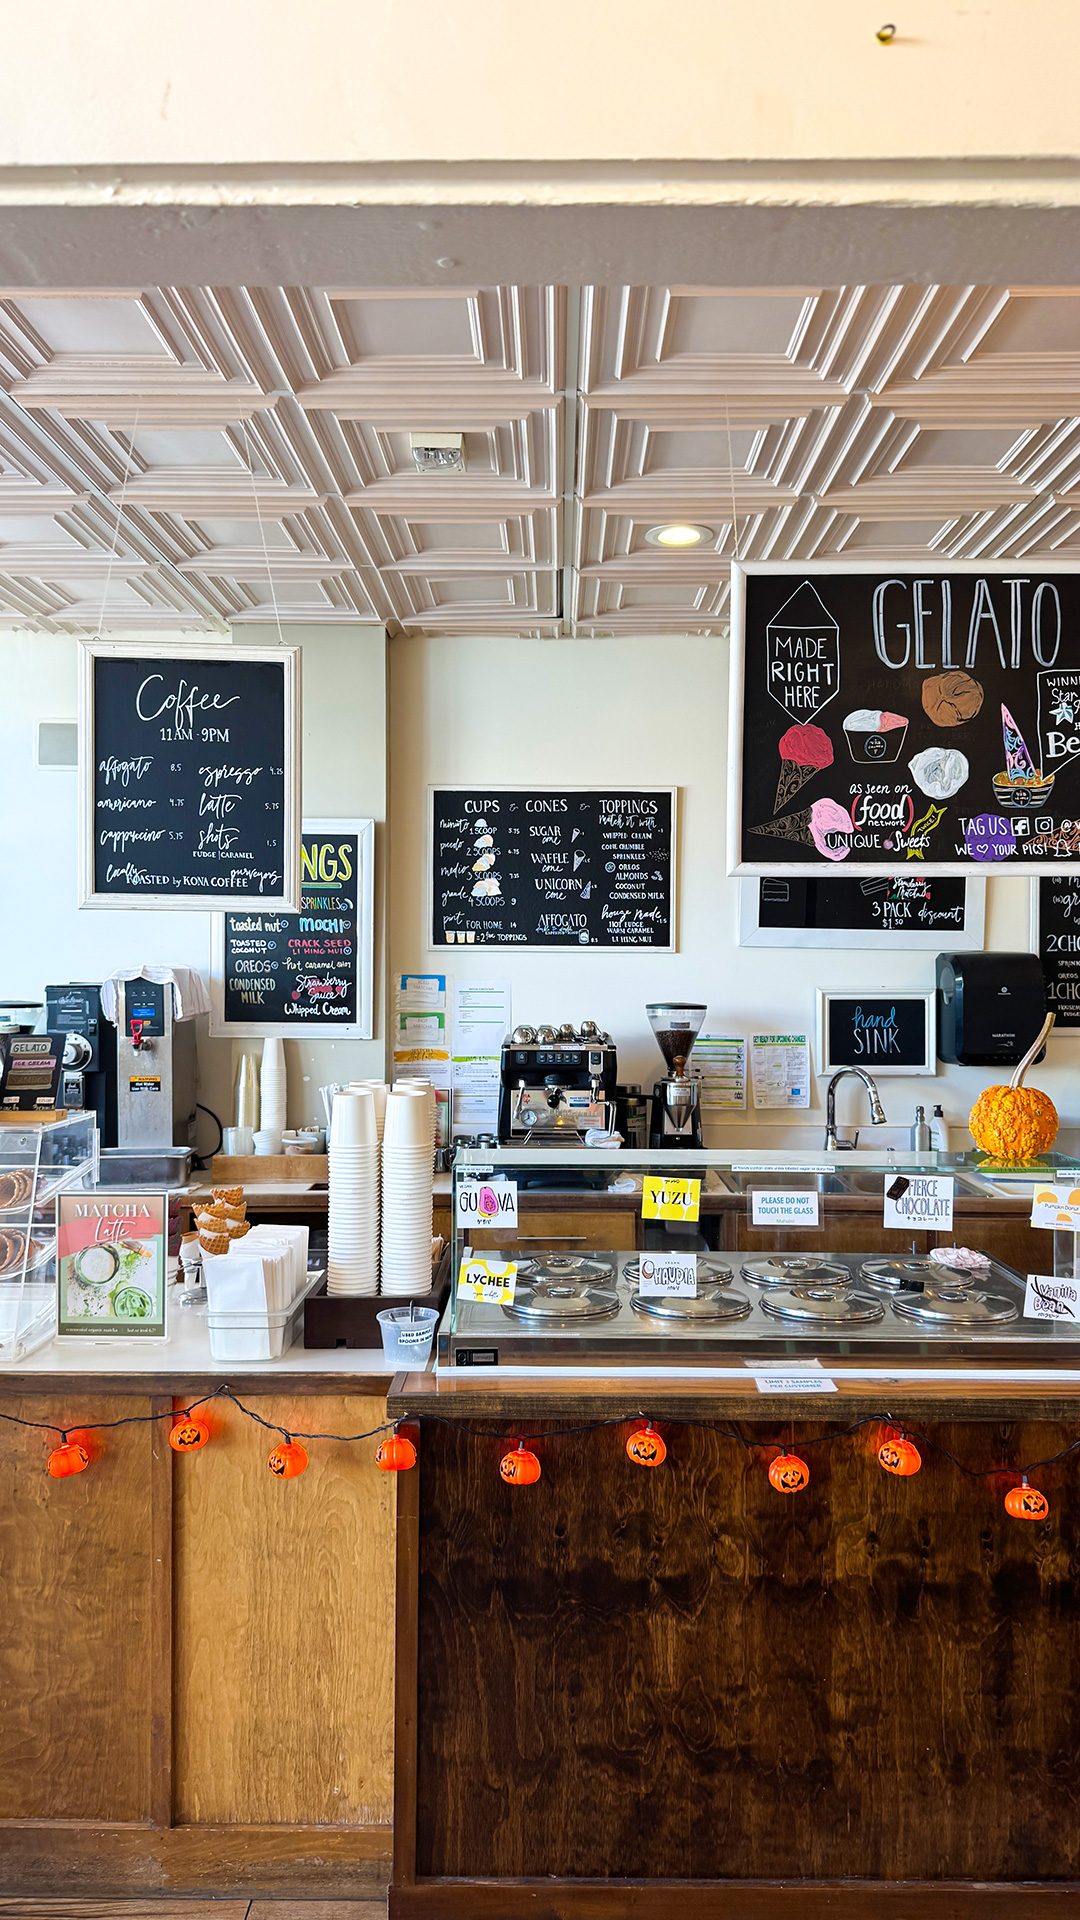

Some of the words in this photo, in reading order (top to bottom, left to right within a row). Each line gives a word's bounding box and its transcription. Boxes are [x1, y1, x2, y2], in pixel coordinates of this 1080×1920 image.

[872, 578, 1062, 670] GELATO
[774, 636, 828, 659] MADE
[771, 662, 834, 686] RIGHT
[1046, 676, 1080, 687] WINN
[136, 674, 240, 730] Coffee
[784, 686, 820, 708] HERE
[160, 728, 194, 741] 11AM
[202, 730, 230, 743] 9PM
[99, 756, 154, 787] affogato
[850, 784, 862, 794] as
[865, 784, 890, 794] seen
[894, 784, 913, 794] on
[97, 797, 156, 812] americano
[198, 792, 242, 818] latte
[464, 800, 500, 814] CUPS
[526, 799, 568, 812] CONES
[599, 800, 658, 814] TOPPINGS
[855, 794, 907, 826] food
[917, 815, 936, 832] TWICE!
[958, 818, 986, 836] TAG
[989, 818, 1008, 836] US
[100, 828, 166, 852] cappuccino
[198, 822, 240, 850] shots
[529, 826, 562, 837] SUGAR
[542, 836, 561, 846] cone
[826, 834, 882, 848] UNIQUE
[893, 830, 930, 852] Sweets
[220, 852, 254, 860] CARAMEL
[473, 848, 502, 856] SCOOPS
[955, 844, 974, 856] WE
[994, 844, 1019, 856] YOUR
[1022, 843, 1048, 855] PICS!
[531, 853, 570, 864] WAFFLE
[106, 862, 148, 883] locally
[542, 864, 564, 873] cone
[126, 874, 170, 886] ROASTED
[172, 876, 182, 886] by
[183, 876, 210, 886] KONA
[210, 876, 248, 888] COFFEE
[474, 872, 502, 880] SCOOPS
[615, 872, 648, 880] ALMONDS
[534, 878, 582, 890] UNICORN
[468, 898, 474, 906] 4
[476, 897, 506, 906] SCOOPS
[545, 890, 566, 900] cone
[302, 896, 340, 910] SPRINKLES
[872, 902, 880, 916] 3
[884, 902, 912, 918] PACK
[918, 902, 964, 924] discount
[230, 917, 262, 932] toasted
[264, 919, 282, 932] nut
[466, 920, 482, 930] FOR
[484, 920, 504, 930] HOME
[540, 914, 587, 927] AFFOGATO
[497, 932, 528, 941] TOPPINGS
[288, 940, 320, 948] CRACK
[324, 940, 351, 948] SEED
[235, 960, 271, 973] OREOS
[305, 961, 336, 970] caramel
[230, 978, 276, 991] CONDENSED
[296, 972, 352, 998] Strawberry
[241, 992, 265, 1004] MILK
[308, 992, 339, 1003] Sauce
[284, 1002, 320, 1017] Whipped
[323, 1002, 351, 1015] Cream
[852, 1006, 898, 1028] hand
[854, 1027, 901, 1054] SINK
[13, 1044, 48, 1052] GELATO
[908, 1179, 938, 1196] FIERCE
[651, 1190, 692, 1206] YUZU
[75, 1204, 150, 1218] MATCHA
[895, 1198, 950, 1216] CHOCOLATE
[94, 1216, 136, 1243] Latte
[466, 1274, 510, 1288] LYCHEE
[654, 1266, 696, 1285] HAUPIA
[1040, 1284, 1077, 1302] Vanilla
[1034, 1296, 1064, 1312] Bean
